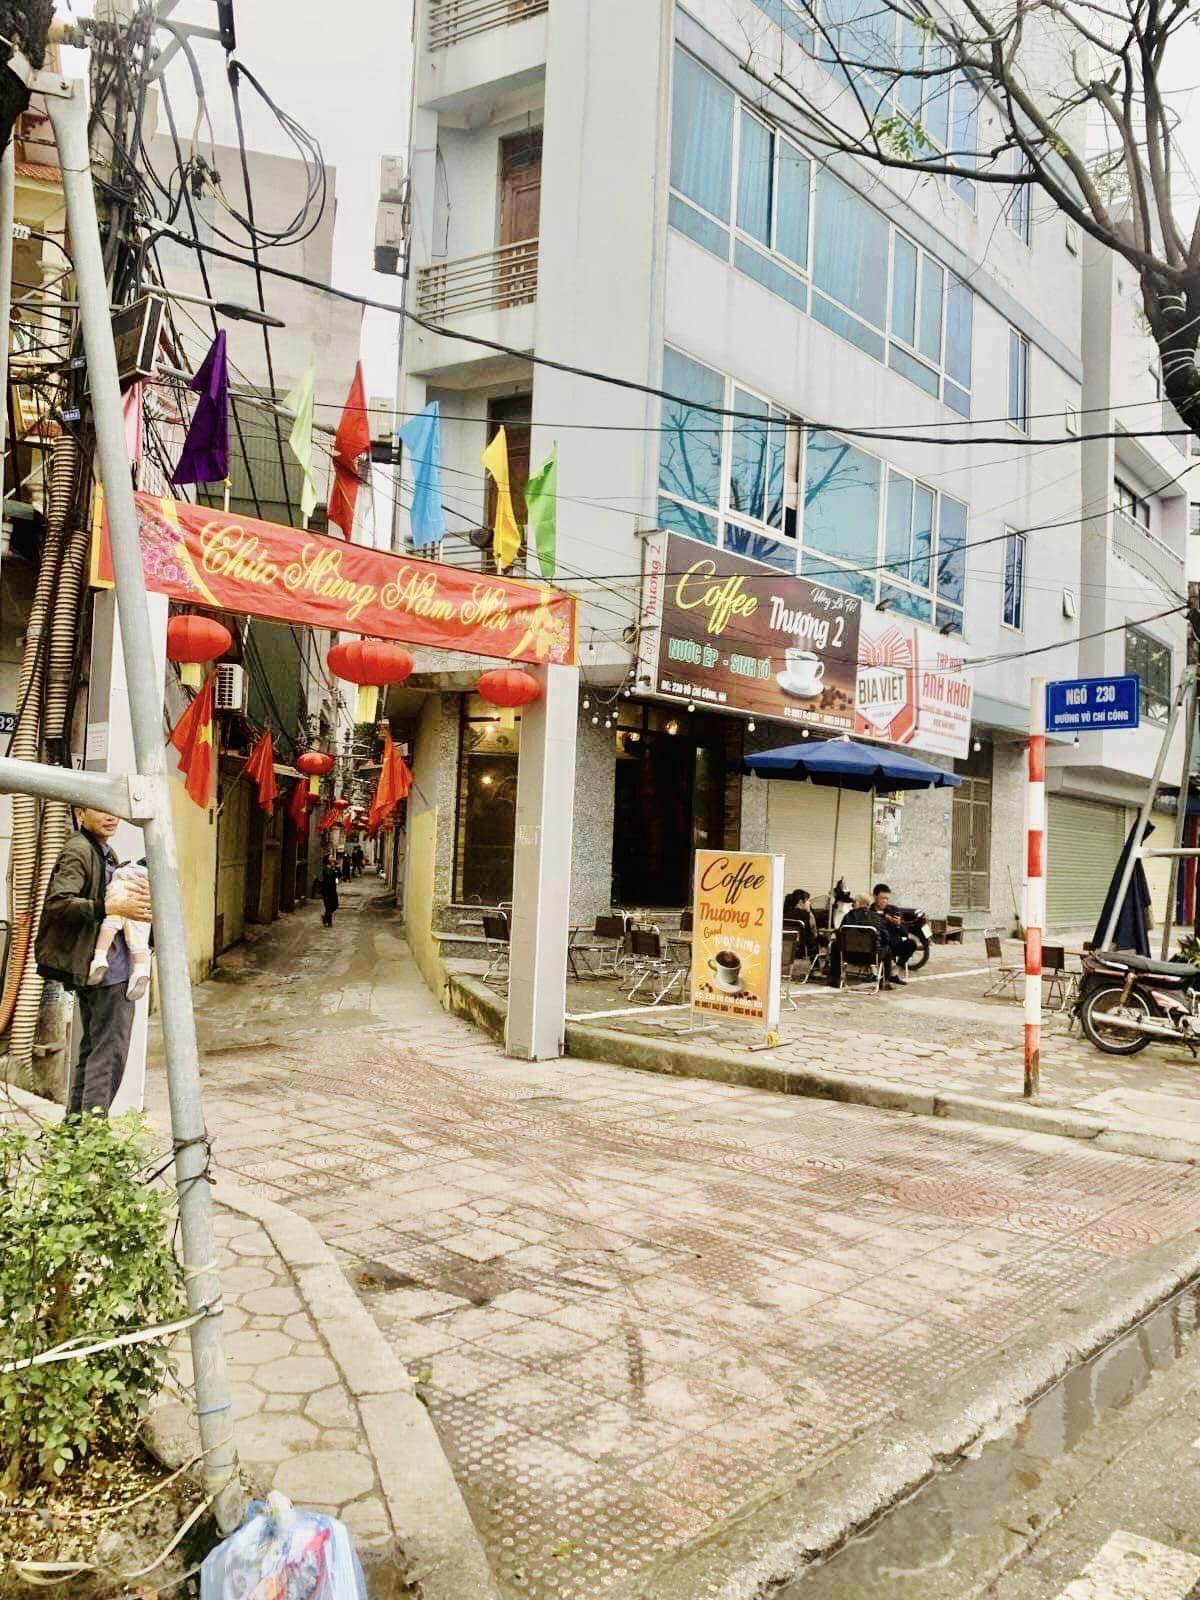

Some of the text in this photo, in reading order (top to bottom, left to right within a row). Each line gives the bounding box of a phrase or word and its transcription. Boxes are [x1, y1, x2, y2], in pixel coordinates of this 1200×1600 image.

[650, 544, 661, 555] 2
[676, 559, 759, 635] Coffee
[769, 595, 844, 649] Thương 2
[858, 677, 879, 705] BIA
[1095, 685, 1116, 703] 230
[700, 856, 766, 905] Coffee
[754, 907, 765, 927] 2
